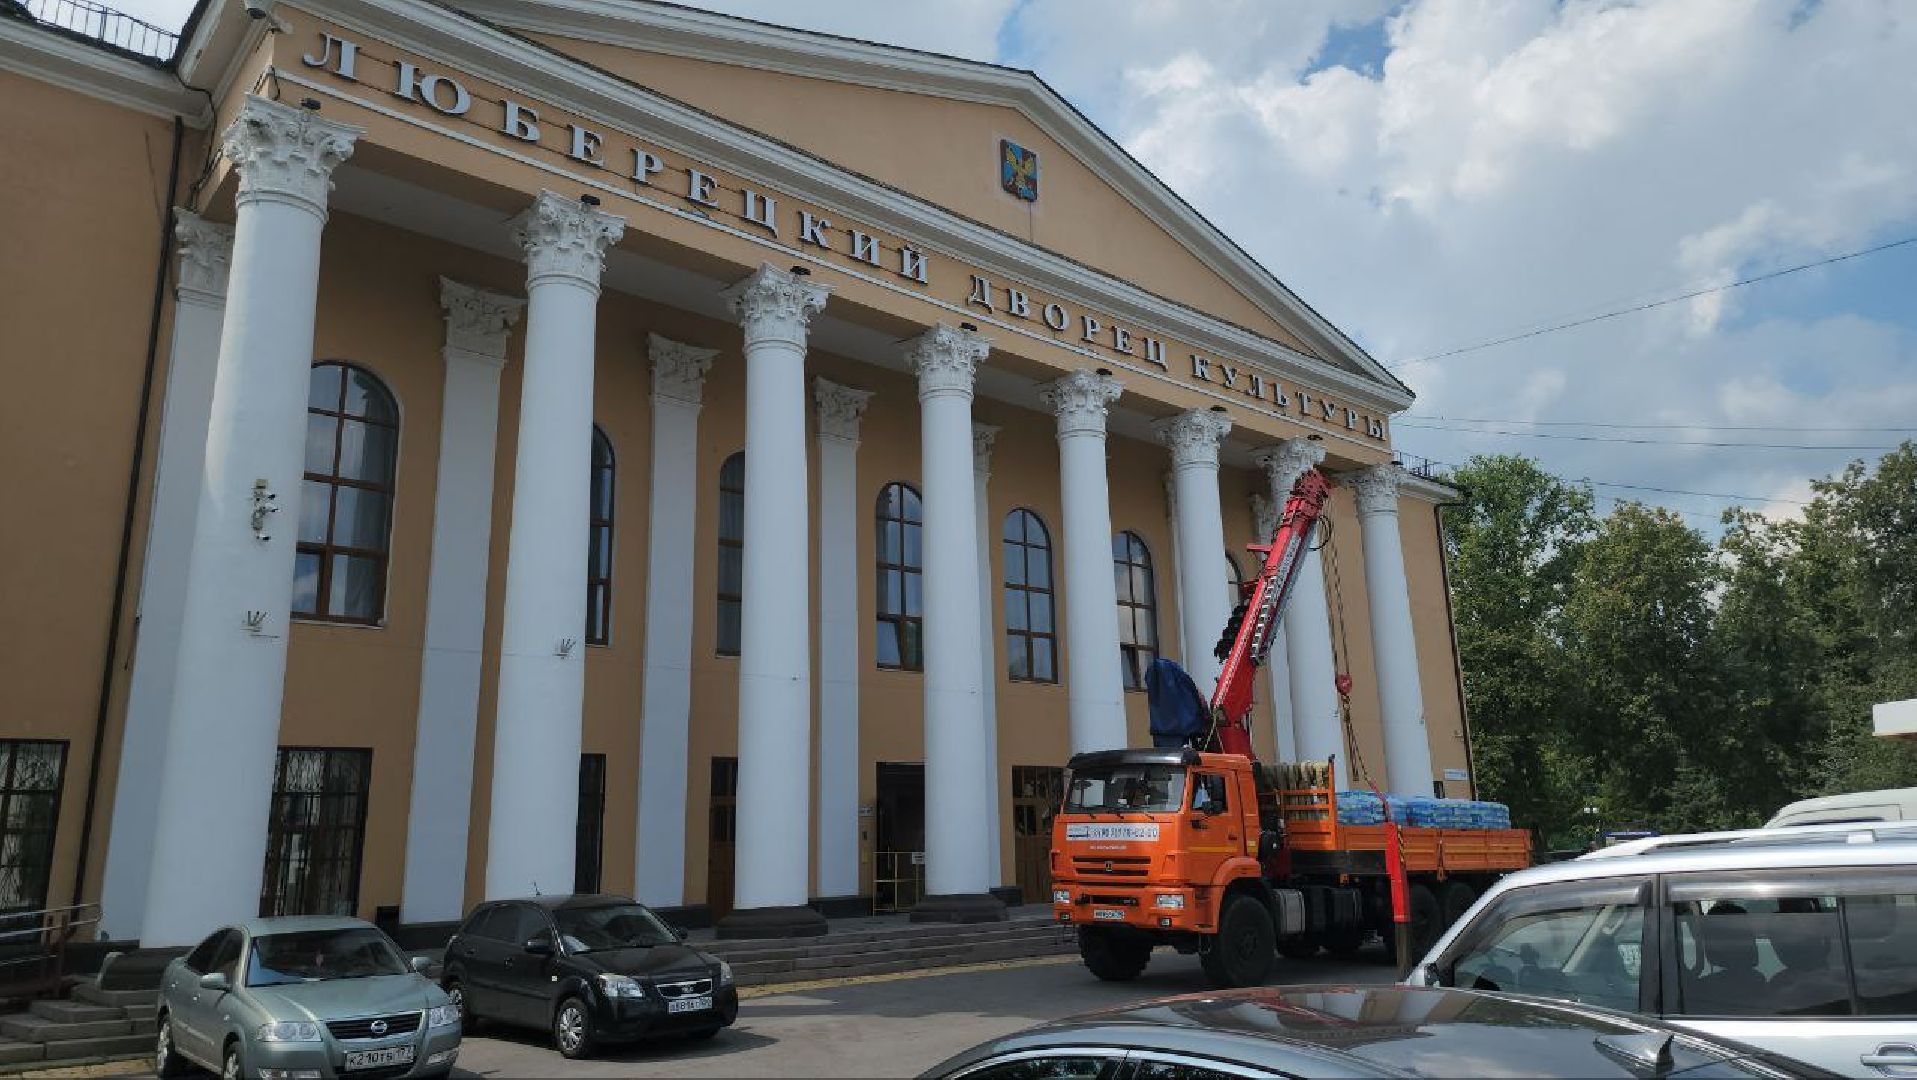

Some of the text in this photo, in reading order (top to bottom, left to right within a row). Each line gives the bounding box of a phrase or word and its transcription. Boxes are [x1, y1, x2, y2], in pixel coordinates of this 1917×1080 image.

[303, 32, 1387, 441] ЛЮБЕРЕЦКИЙ ДВОРЕЦ КУЛЬТУРЫ
